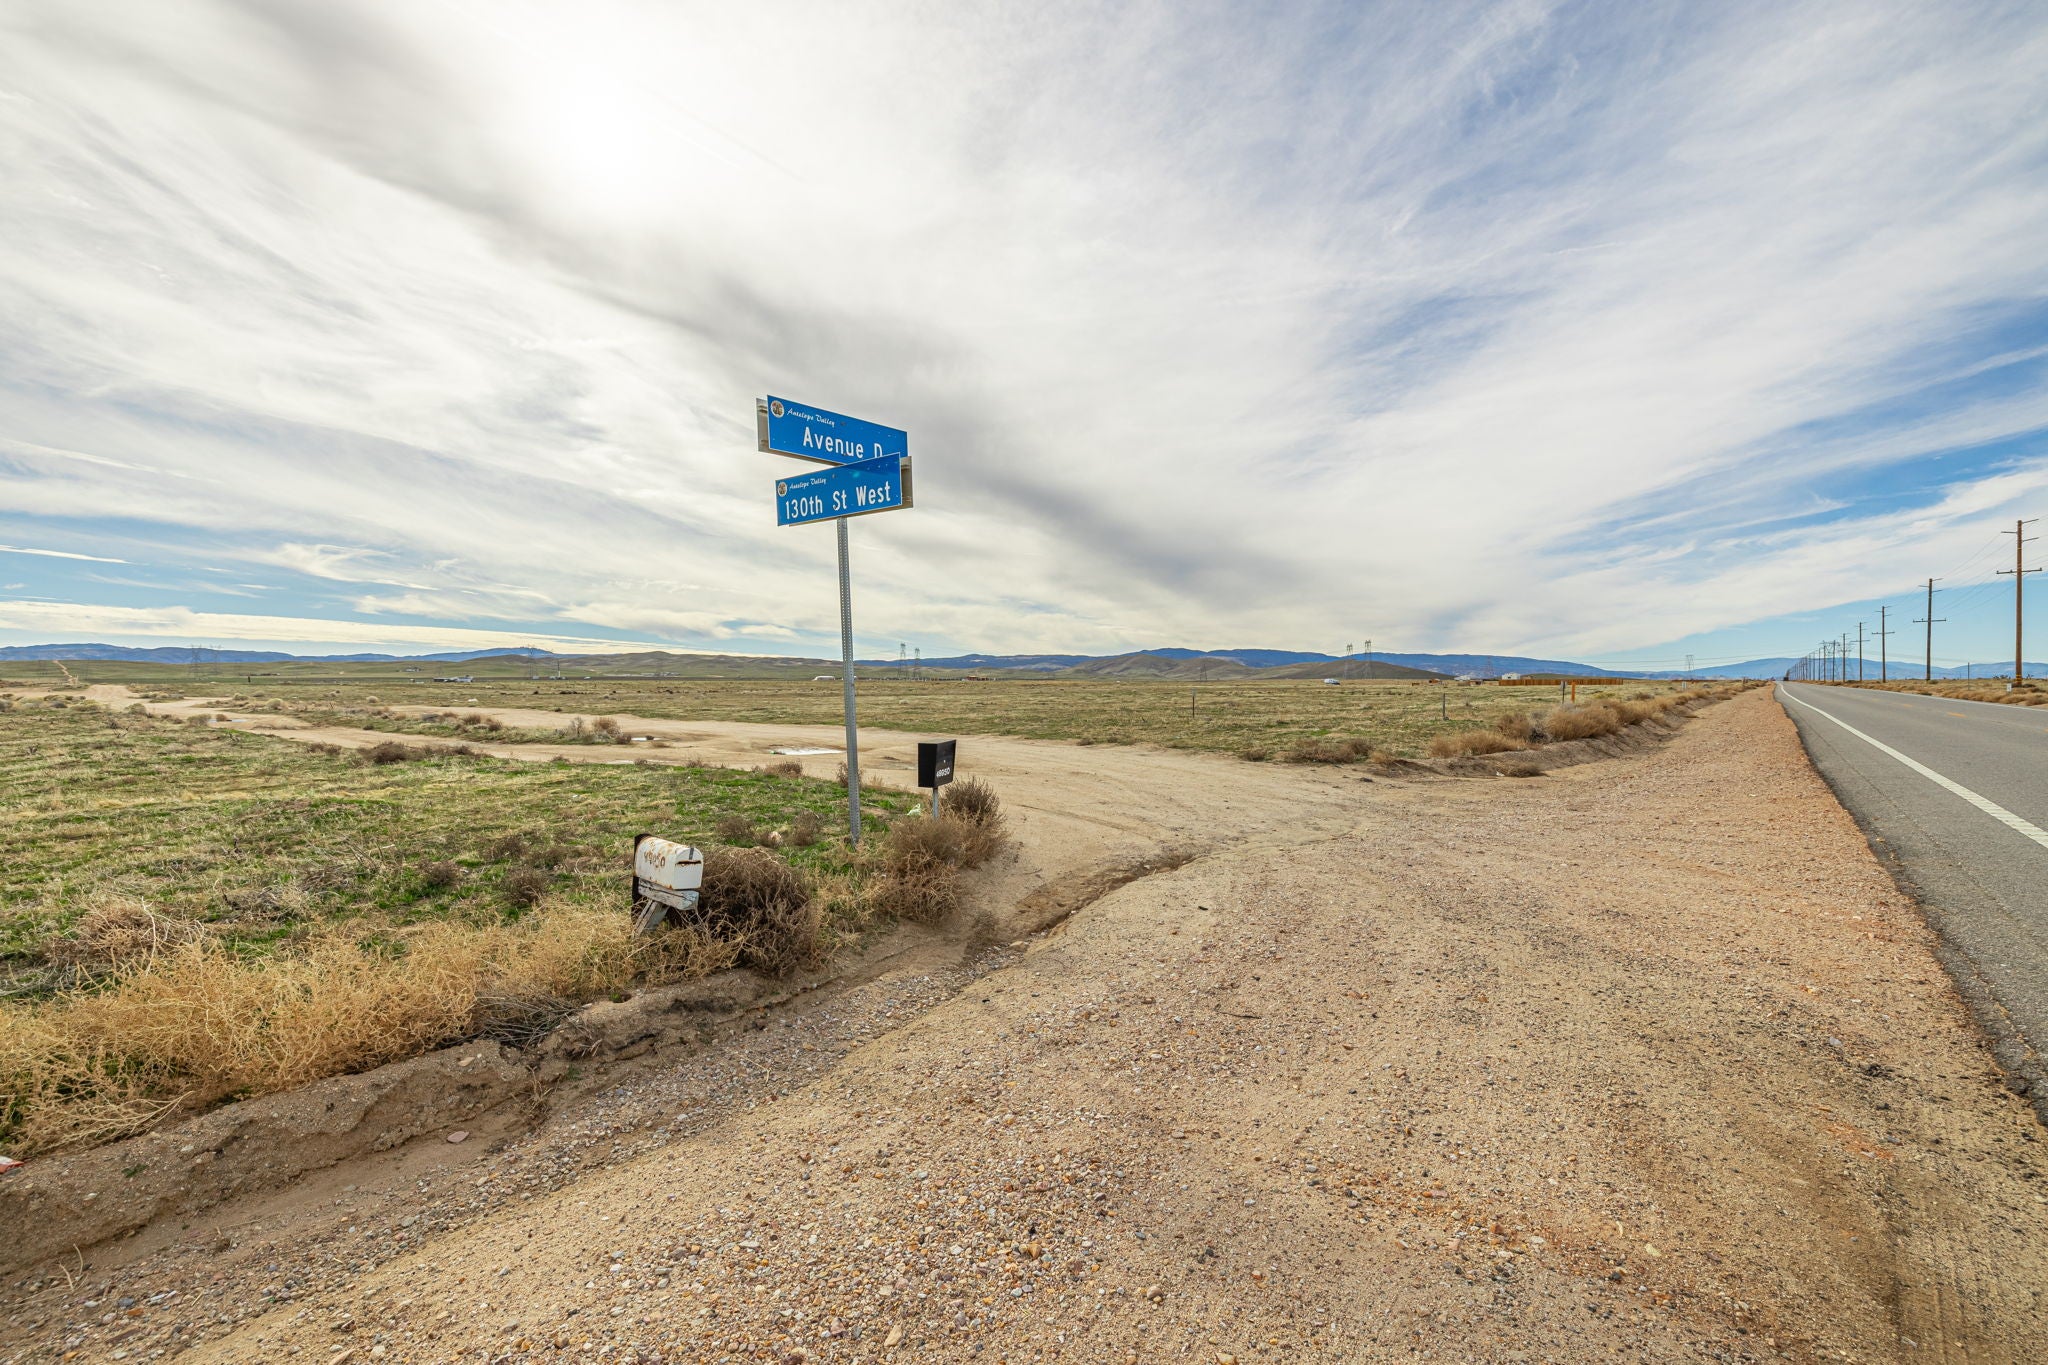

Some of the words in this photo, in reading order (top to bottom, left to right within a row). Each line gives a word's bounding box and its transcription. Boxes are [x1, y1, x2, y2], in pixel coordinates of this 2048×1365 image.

[787, 408, 814, 421] Antelope
[816, 414, 835, 427] Valley
[803, 427, 864, 459] Avenue
[789, 482, 809, 490] Antelope
[786, 495, 823, 519] 130th
[833, 490, 847, 511] St
[856, 481, 891, 506] West
